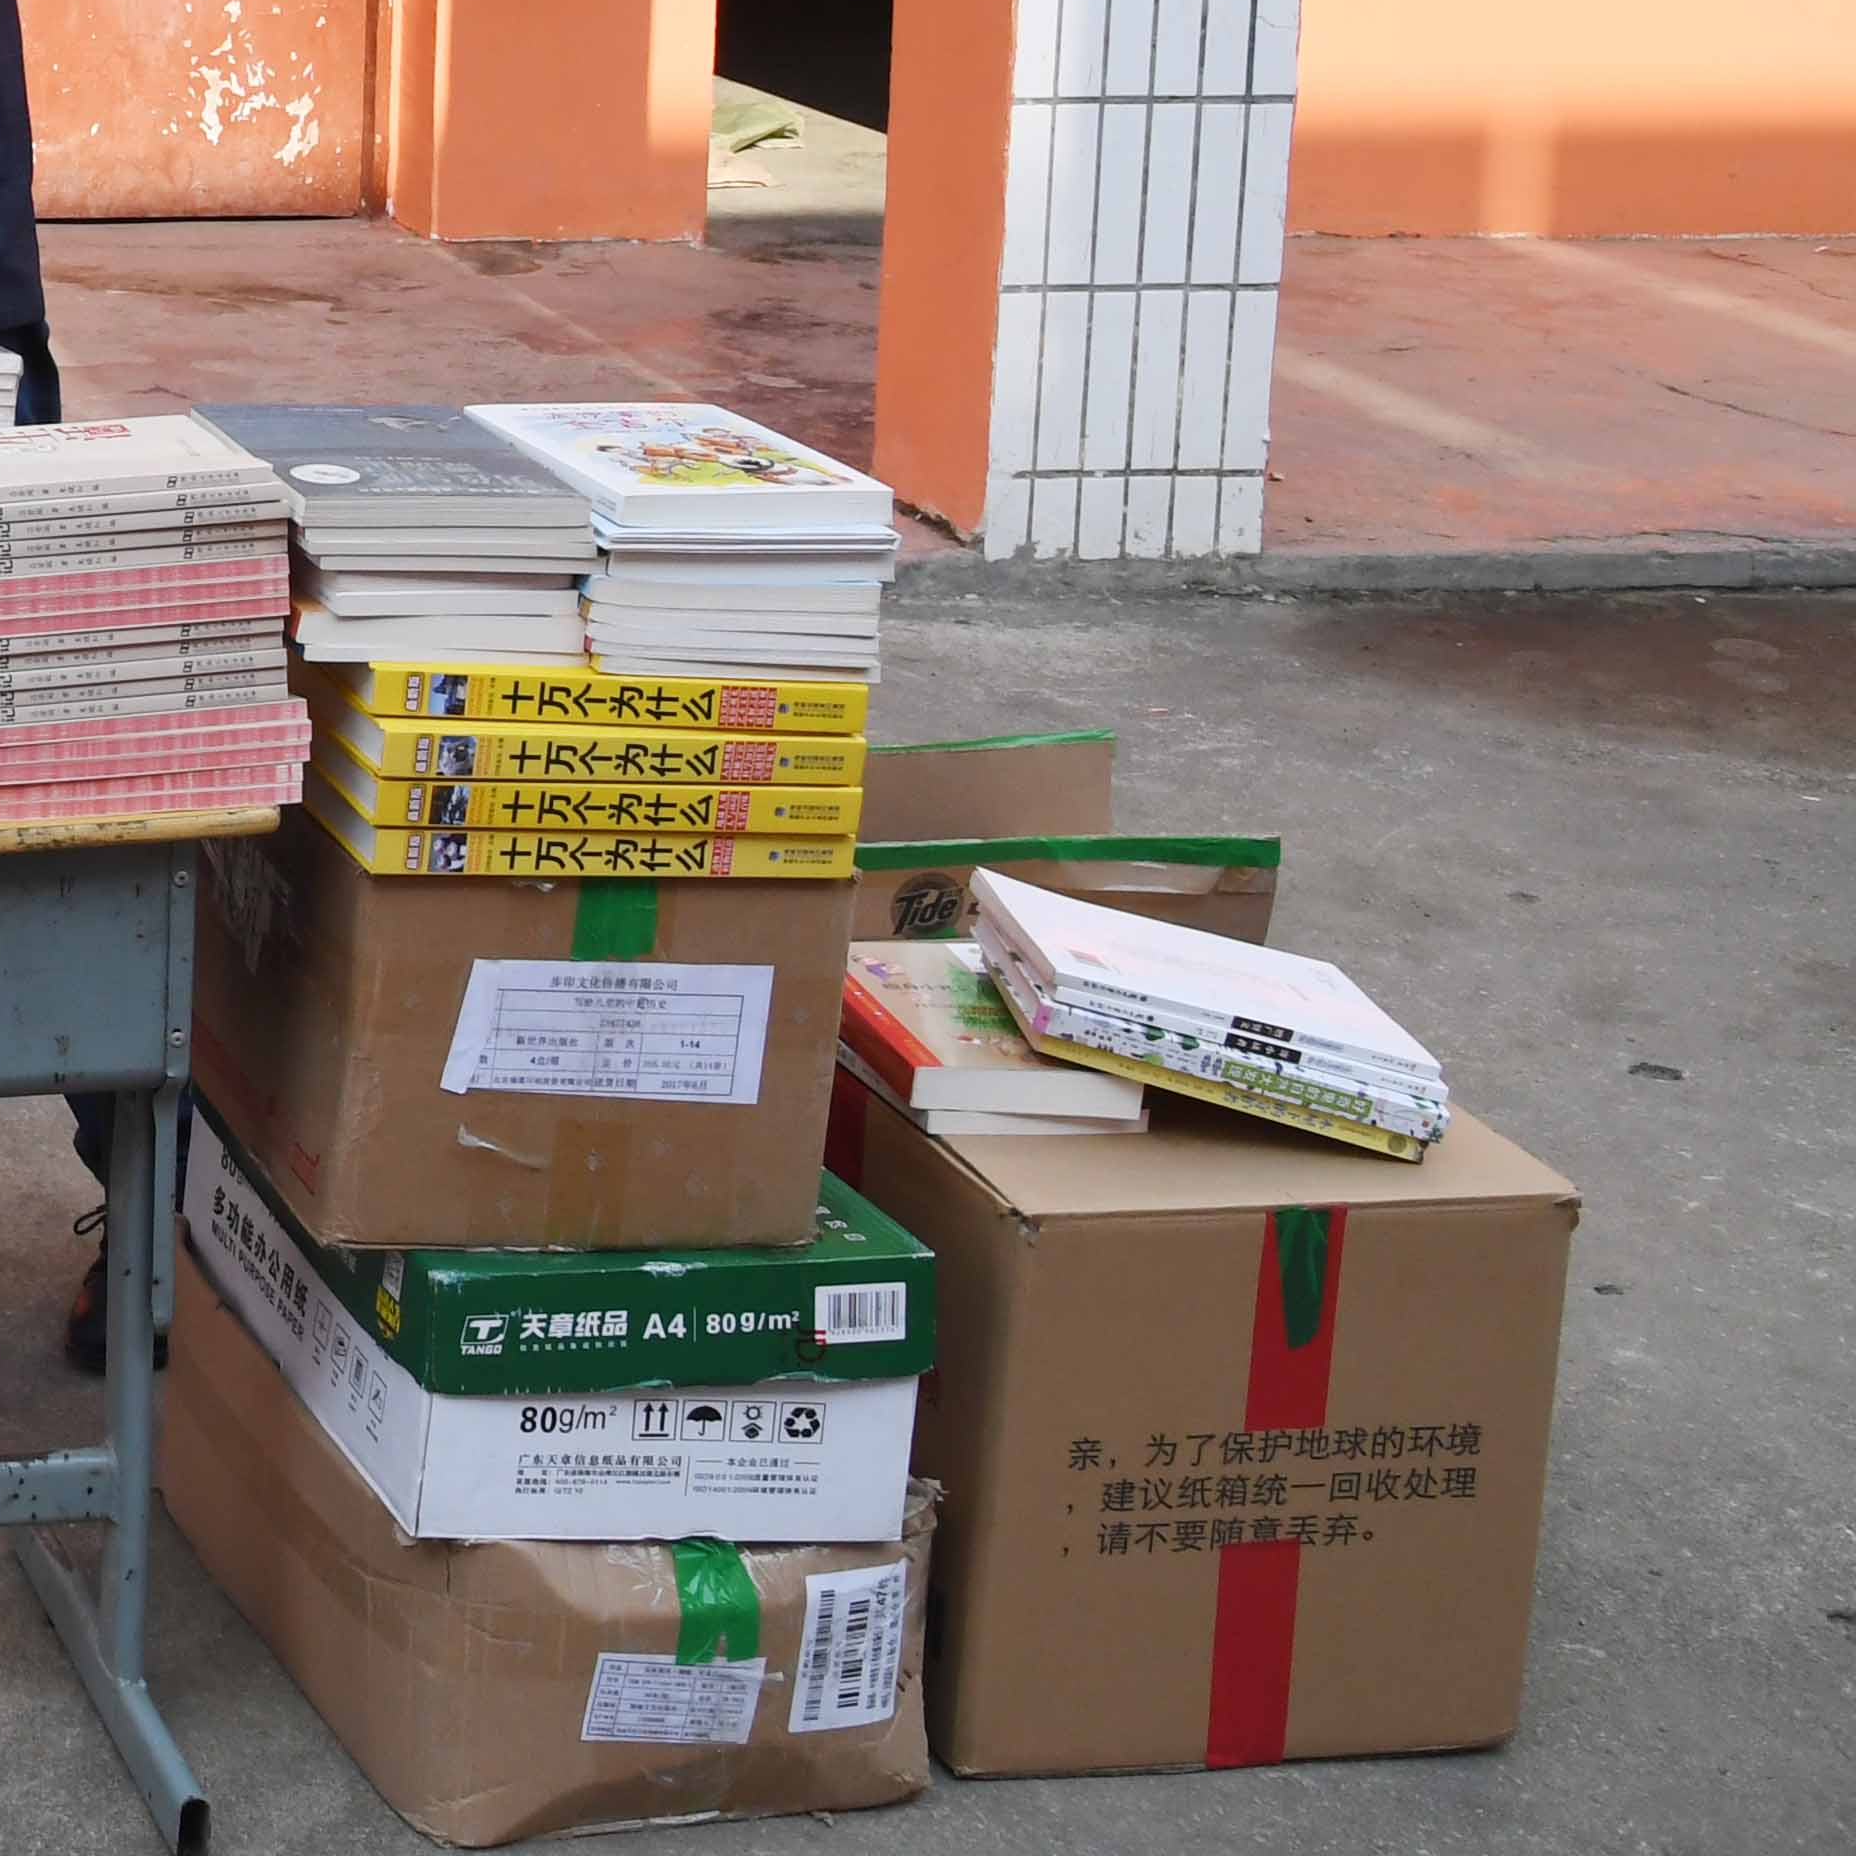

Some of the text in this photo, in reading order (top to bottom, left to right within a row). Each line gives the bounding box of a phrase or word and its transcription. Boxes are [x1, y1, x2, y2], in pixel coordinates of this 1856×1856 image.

[501, 680, 716, 721] 十万个为什么
[509, 741, 720, 779] 十万个为什么
[501, 790, 715, 828] 十万个为什么
[498, 836, 709, 872] 十万个为什么
[894, 885, 958, 937] Tide
[213, 1185, 310, 1317] 多功能办公用纸
[238, 1248, 276, 1306] PURPOSE
[519, 1310, 629, 1341] 天章纸品
[642, 1317, 687, 1341] A4
[460, 1344, 503, 1355] TANGO
[1067, 1422, 1483, 1474] 亲，为了保护地球的环境
